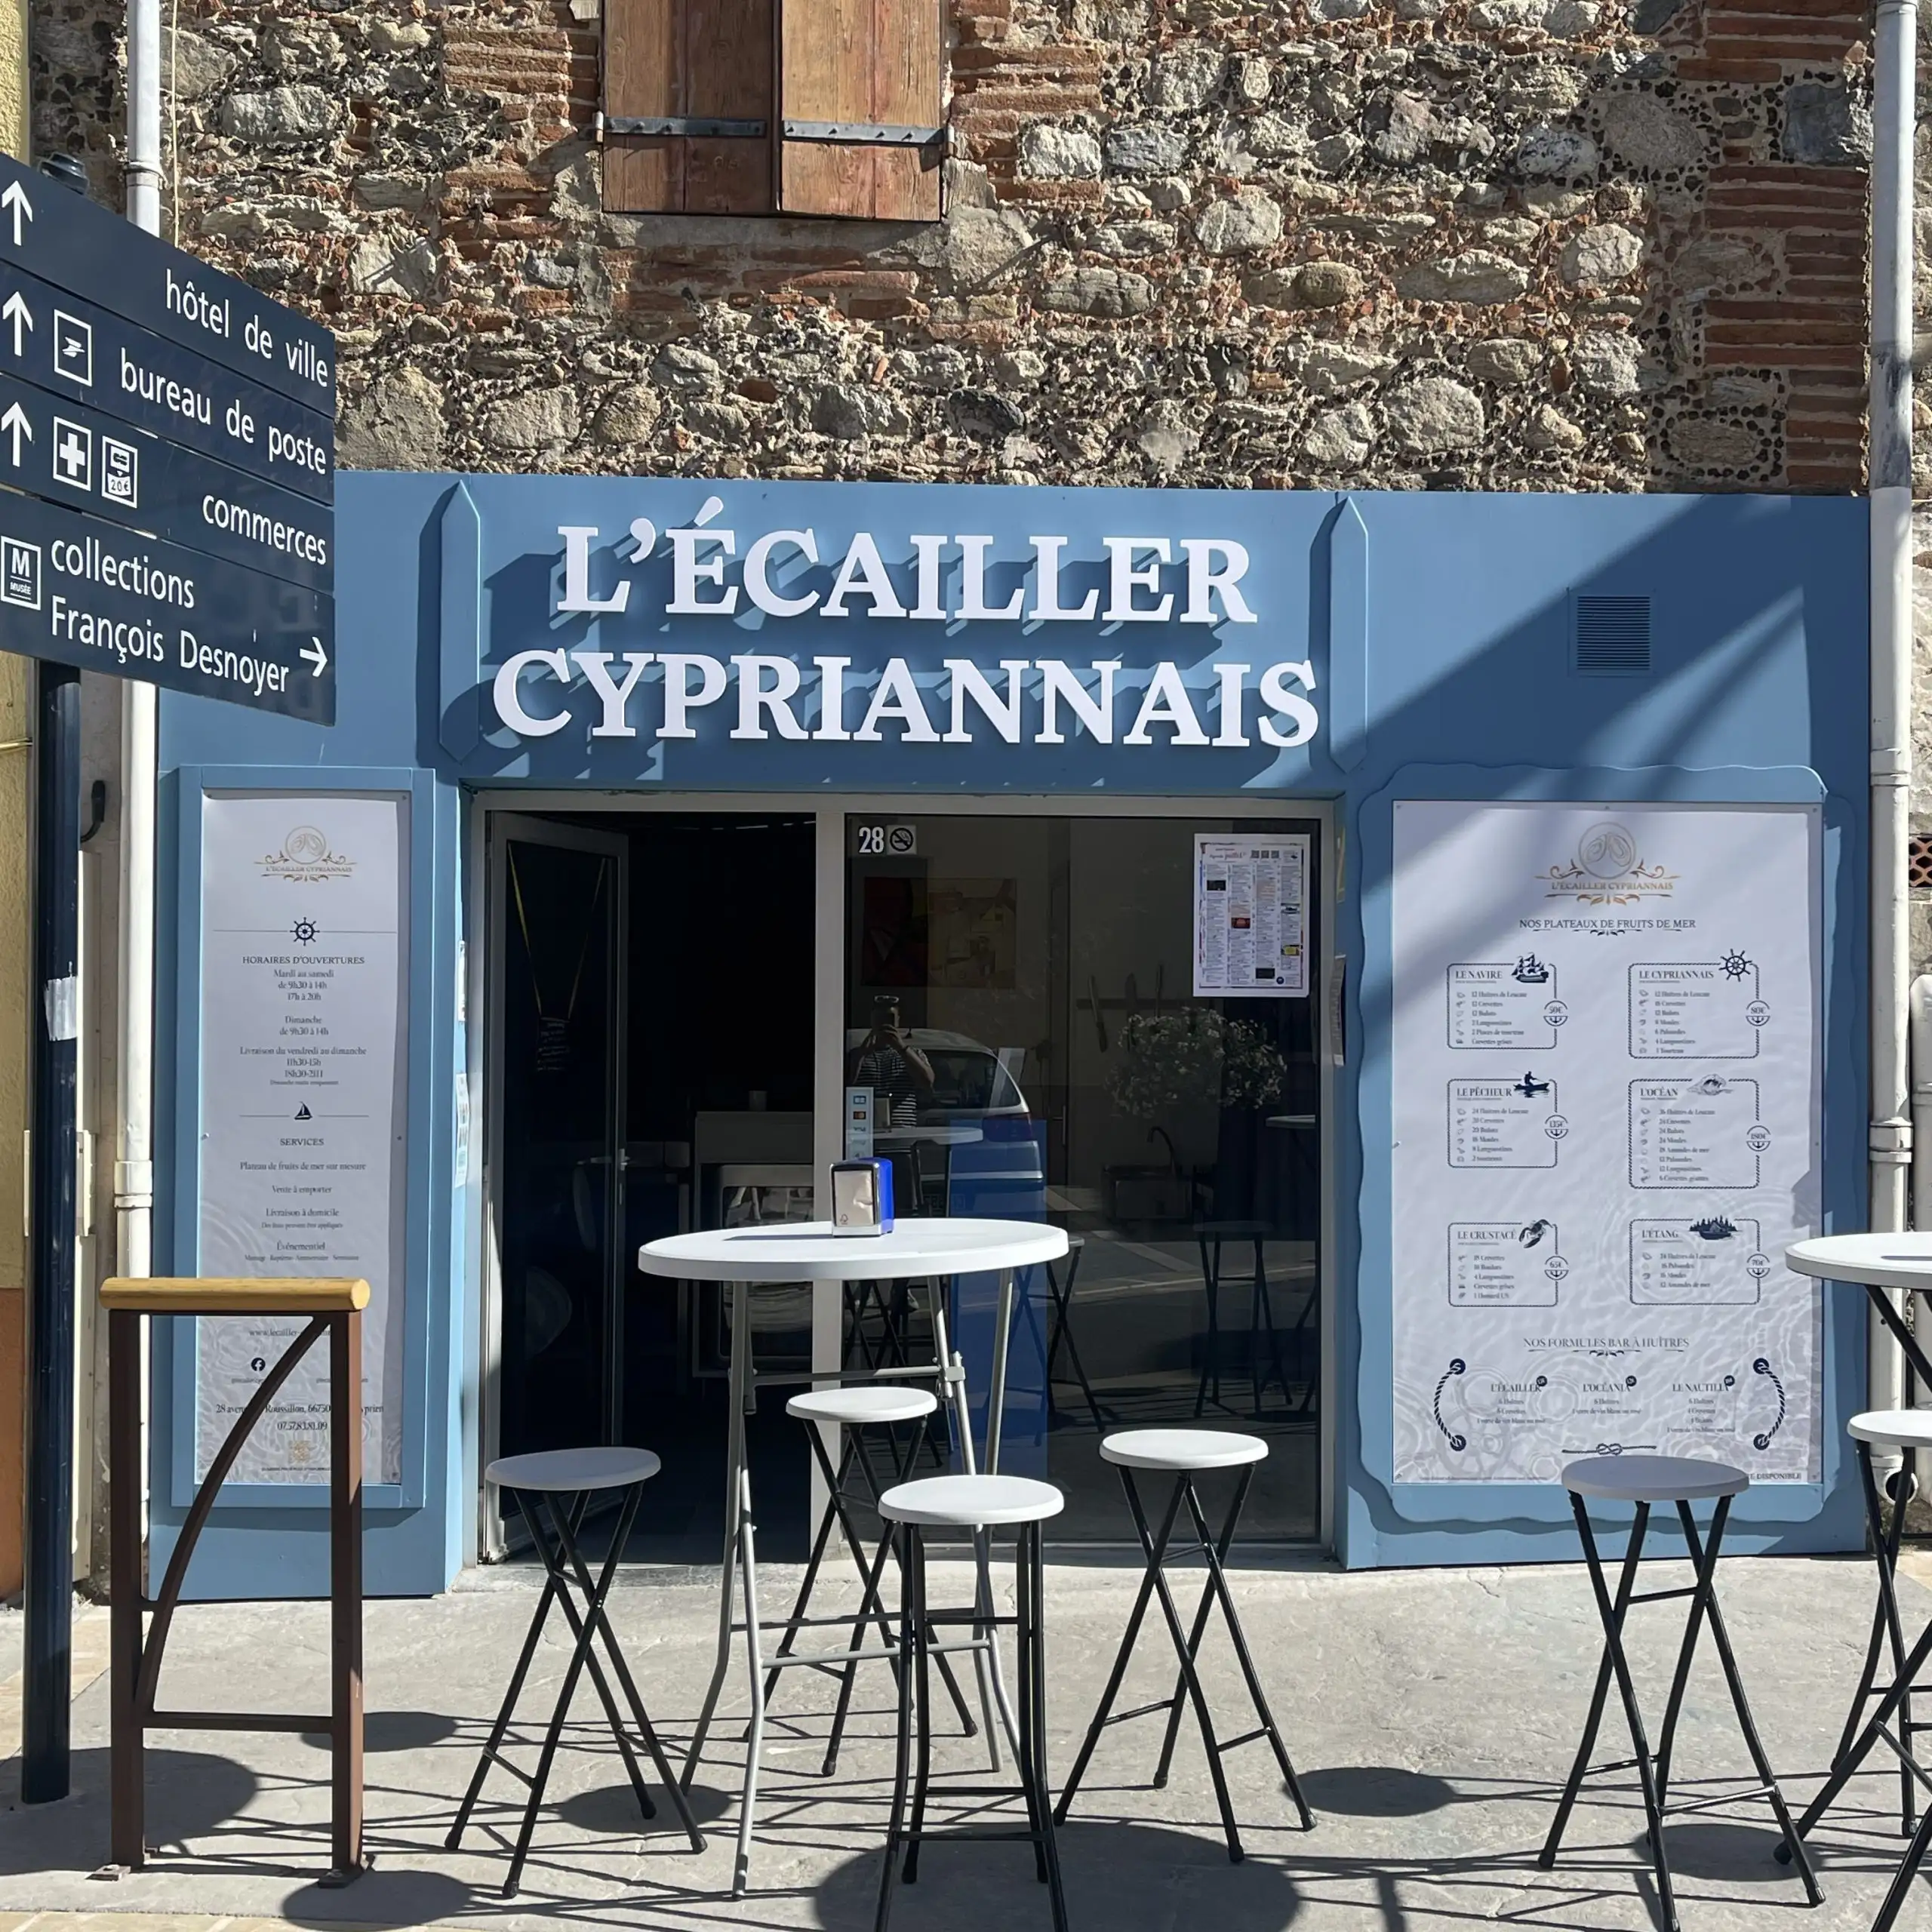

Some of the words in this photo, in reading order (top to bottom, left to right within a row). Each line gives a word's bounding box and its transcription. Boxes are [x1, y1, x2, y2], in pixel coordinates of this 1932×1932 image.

[166, 267, 229, 339] hôtel
[244, 314, 272, 359] de
[285, 337, 328, 388] ville
[120, 346, 211, 425] bureau
[226, 398, 254, 444] de
[268, 425, 326, 475] poste
[202, 494, 327, 565] commerces
[11, 546, 30, 578] M
[556, 495, 1259, 624] L'ÉCAILLER
[51, 535, 195, 609] collections
[51, 594, 164, 664] François
[179, 629, 289, 697] Desnoyer
[492, 646, 1320, 748] CYPRIANNAIS
[858, 827, 884, 854] 28
[1608, 881, 1674, 891] CYPRIANNAIS
[1519, 919, 1542, 929] NOS
[1543, 919, 1598, 929] PLATEAUX
[1600, 919, 1614, 929] DE
[1617, 919, 1654, 929] FRUITS
[1656, 919, 1670, 929] DE
[1672, 919, 1696, 929] MER
[242, 955, 291, 965] HORAIRES
[292, 955, 365, 965] D'OUVERTURES
[273, 969, 296, 978] Mardi
[308, 969, 334, 978] samedi
[1455, 970, 1467, 980] LE
[1468, 970, 1503, 980] NAVIRE
[1639, 970, 1651, 980] LE
[1652, 970, 1715, 980] CYPRIANNAIS
[278, 981, 288, 989] de
[288, 981, 308, 990] 9h30
[309, 981, 314, 989] à
[315, 980, 328, 989] 14h
[287, 992, 300, 1001] 17h
[301, 992, 306, 1001] à
[306, 992, 321, 1001] 20h
[285, 1015, 322, 1024] Dimanche
[279, 1027, 288, 1035] de
[289, 1027, 309, 1036] 9h30
[309, 1027, 315, 1035] à
[315, 1027, 329, 1036] 14h
[240, 1047, 275, 1055] Livraison
[275, 1047, 286, 1055] du
[287, 1047, 319, 1055] vendredi
[331, 1047, 367, 1055] dimanche
[1457, 1087, 1469, 1097] LE
[1469, 1085, 1512, 1097] PÊCHEUR
[1640, 1086, 1678, 1097] L'OCÉAN
[279, 1137, 325, 1146] SERVICES
[240, 1161, 267, 1171] Plateau
[268, 1161, 277, 1171] de
[278, 1161, 300, 1171] fruits
[300, 1161, 309, 1171] de
[272, 1185, 292, 1194] Vente
[299, 1186, 333, 1196] emporter
[266, 1208, 300, 1217] Livraison
[301, 1208, 307, 1217] à
[307, 1208, 340, 1217] domicile
[1457, 1231, 1471, 1240] LE
[1472, 1229, 1518, 1240] CRUSTACÉ
[1641, 1228, 1678, 1238] L'ÉTANG
[276, 1240, 326, 1251] Événementiel
[1523, 1338, 1546, 1348] NOS
[1548, 1338, 1607, 1348] FORMULES
[1609, 1338, 1630, 1348] BAR
[1632, 1337, 1641, 1348] À
[1641, 1336, 1690, 1348] HUÎTRES
[1672, 1383, 1684, 1392] LE
[216, 1403, 226, 1414] 28
[307, 1404, 331, 1414] 66750
